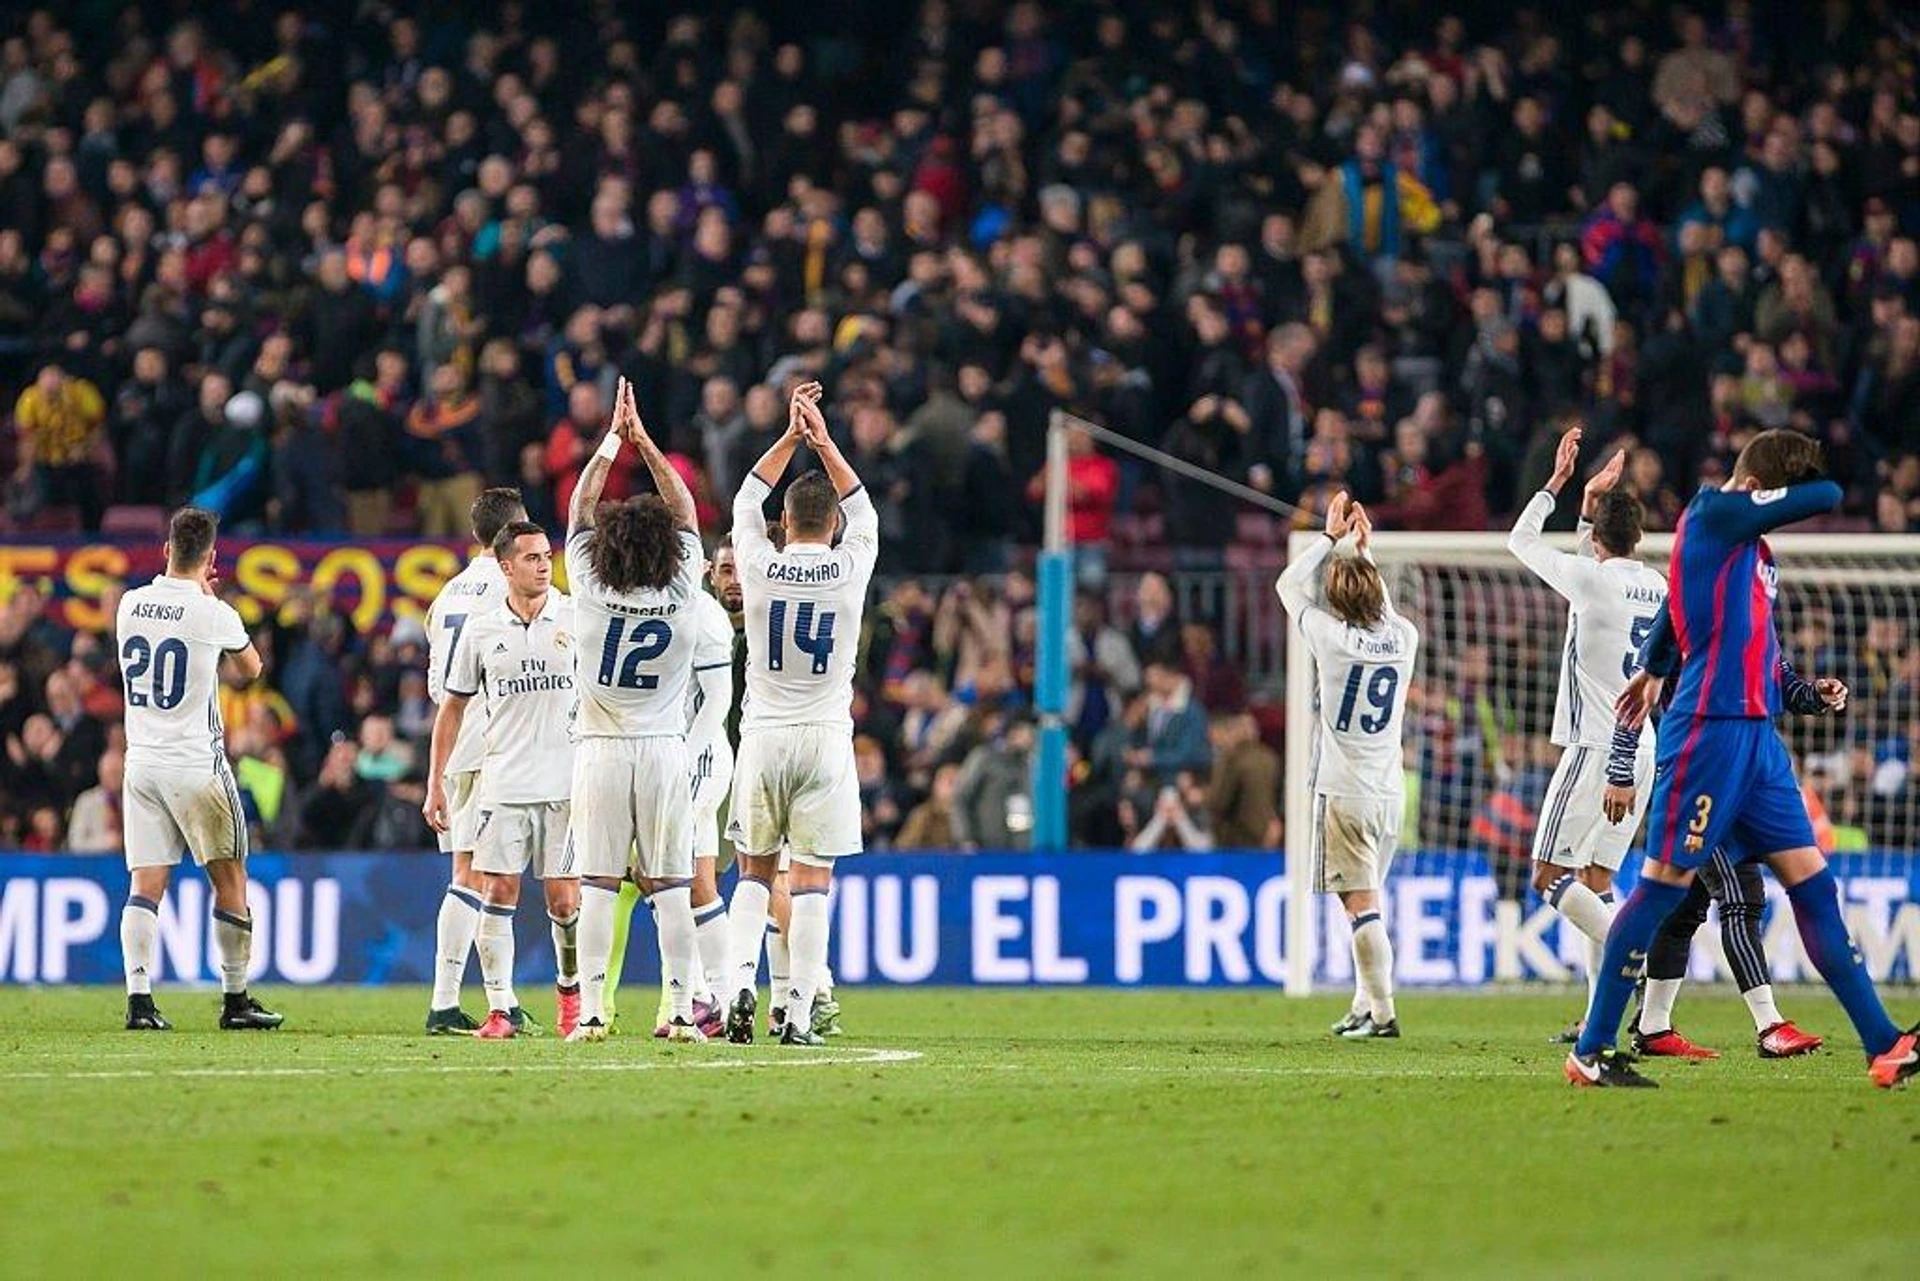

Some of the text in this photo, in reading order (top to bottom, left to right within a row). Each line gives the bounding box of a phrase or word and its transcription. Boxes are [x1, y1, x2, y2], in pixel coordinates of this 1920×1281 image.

[122, 635, 189, 710] 20
[443, 613, 469, 689] 7
[521, 657, 547, 673] Fly
[597, 616, 673, 690] 12
[768, 599, 836, 675] 14
[497, 673, 574, 697] Emirates
[1336, 664, 1399, 735] 19
[476, 809, 493, 841] 7
[1689, 794, 1713, 834] 3
[971, 875, 1089, 983] EL
